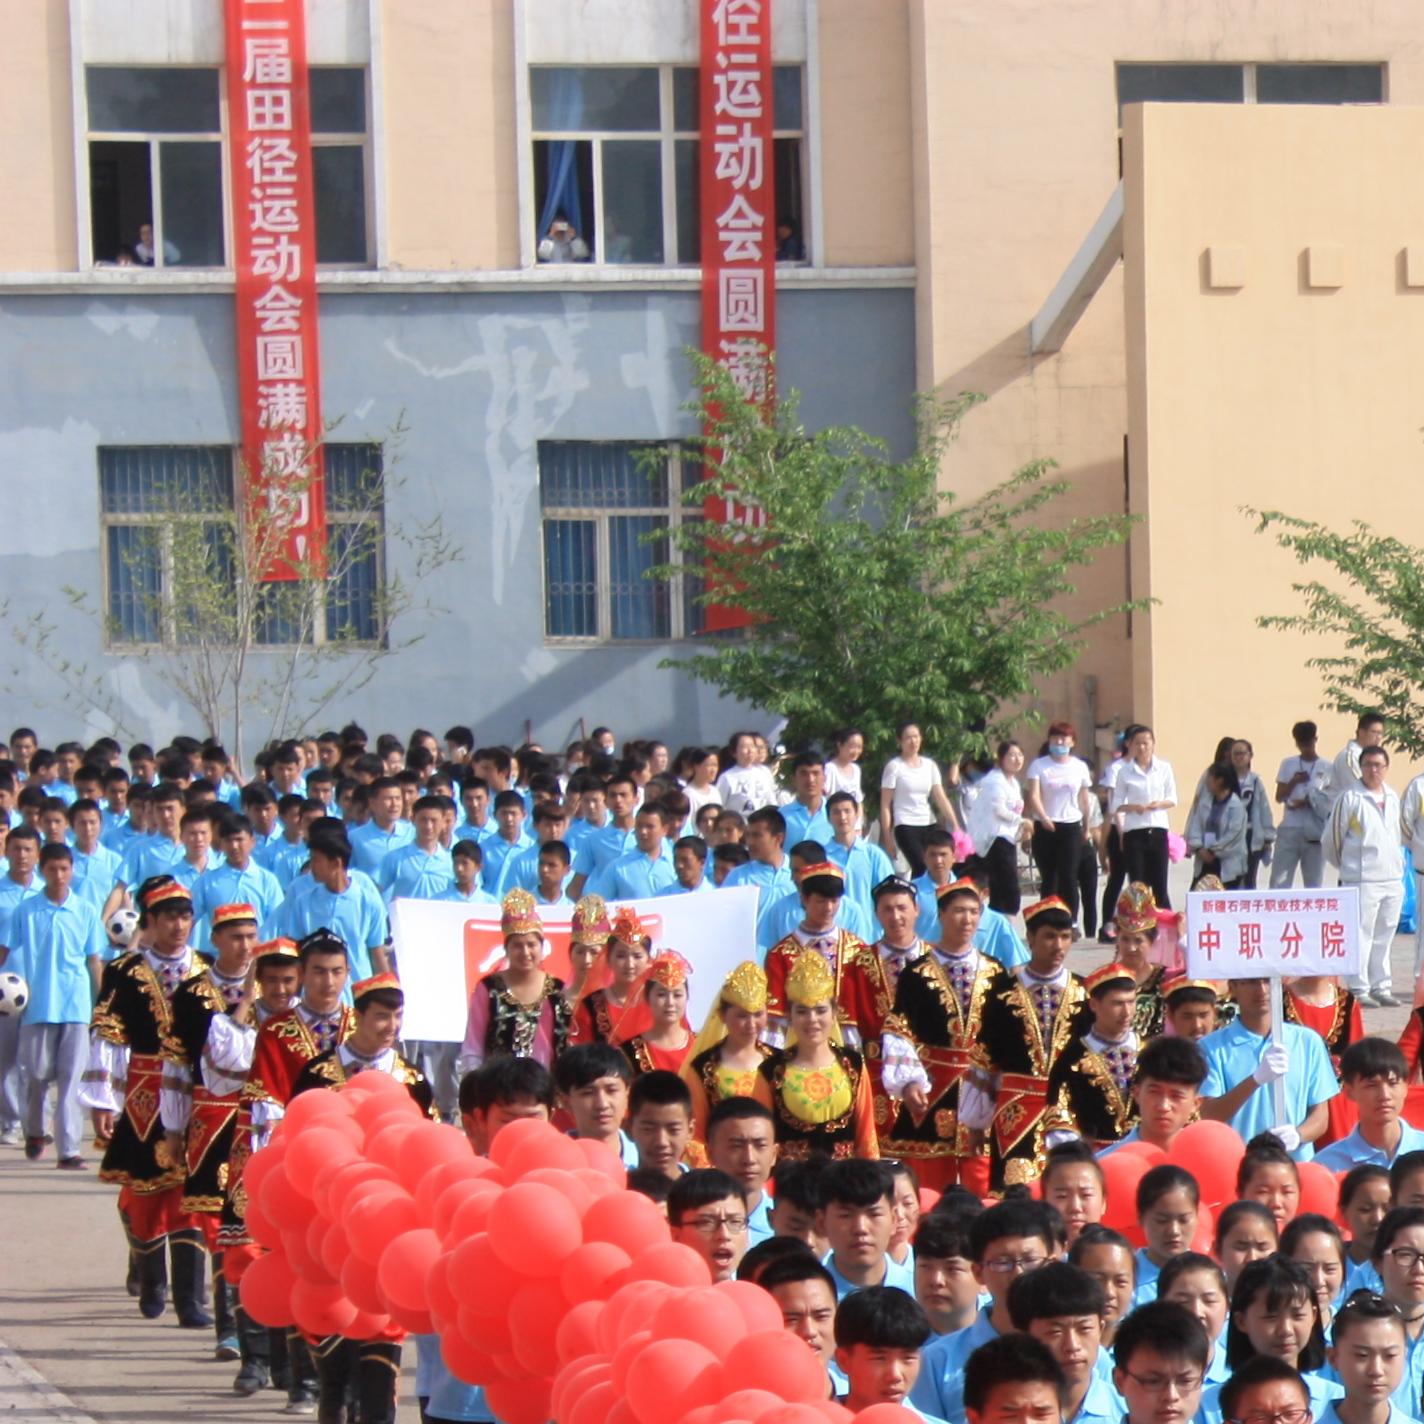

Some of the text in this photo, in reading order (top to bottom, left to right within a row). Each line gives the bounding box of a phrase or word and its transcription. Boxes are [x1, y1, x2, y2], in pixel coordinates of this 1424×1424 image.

[1202, 898, 1339, 913] 新疆石河子职业技术学院
[1198, 921, 1346, 961] 中职分院
